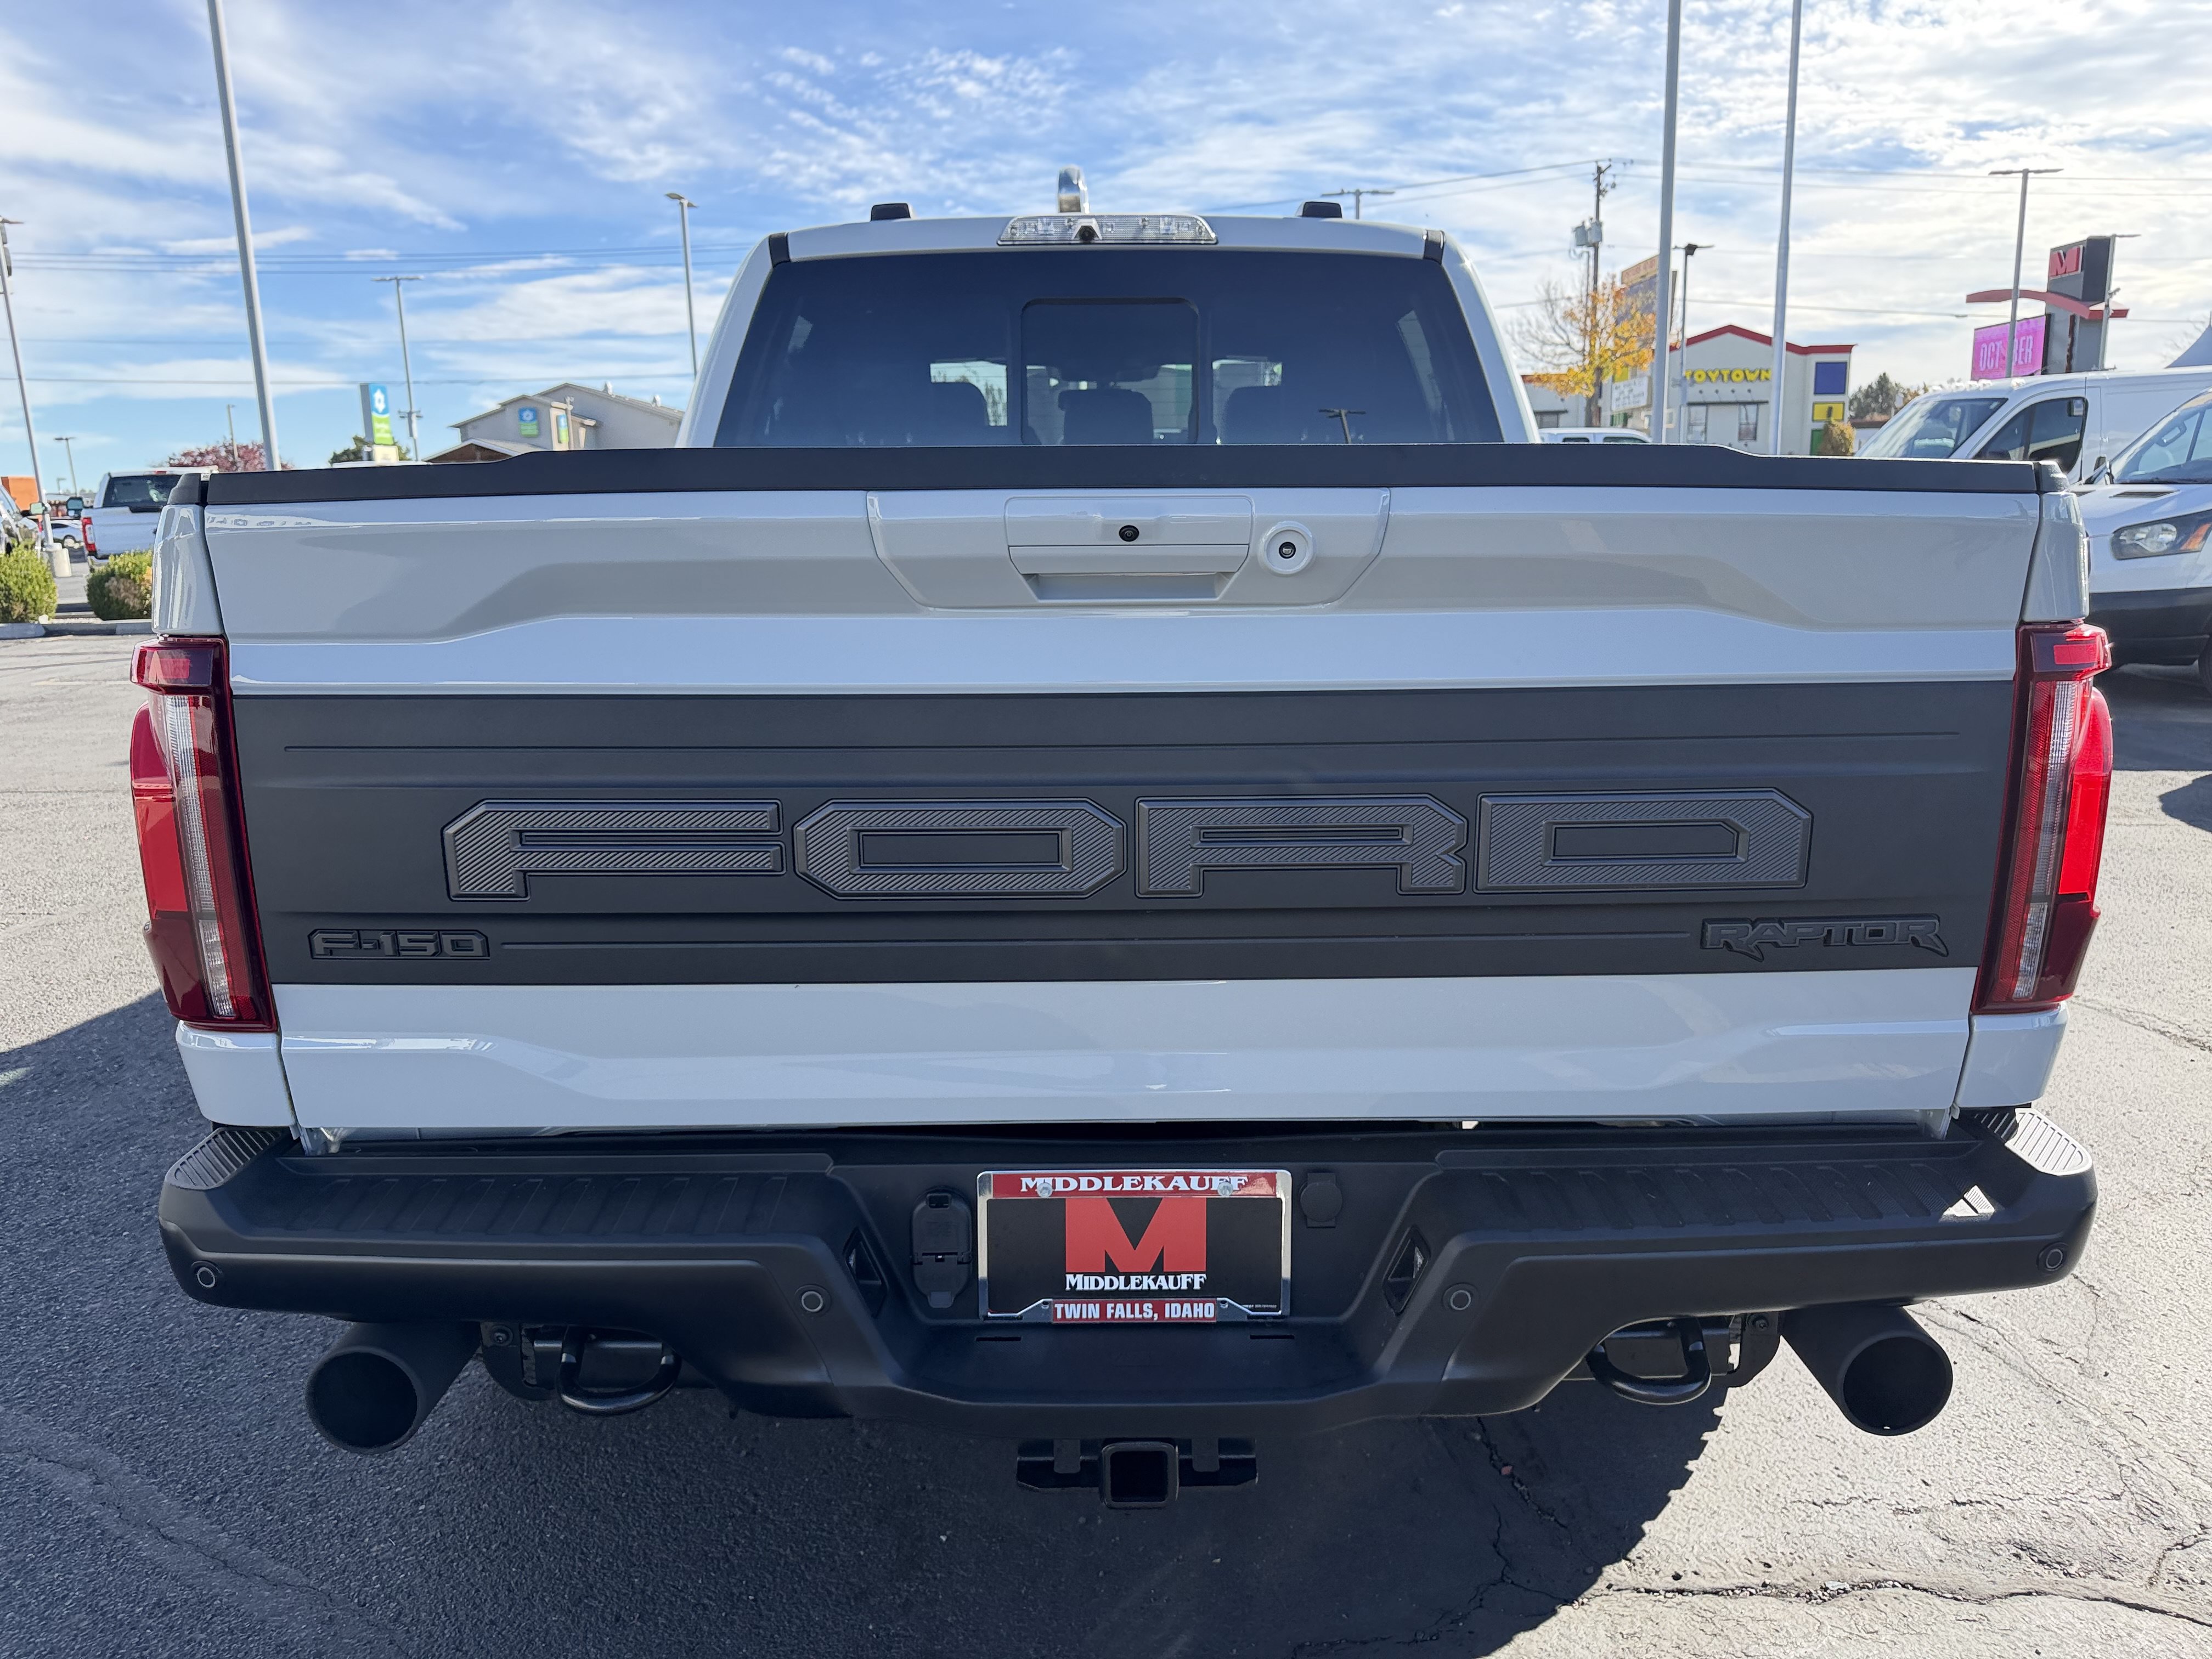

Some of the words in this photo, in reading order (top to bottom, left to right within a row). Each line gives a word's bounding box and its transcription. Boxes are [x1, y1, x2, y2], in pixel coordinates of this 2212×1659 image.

[2049, 245, 2083, 280] M
[1979, 335, 2033, 371] OCTBER
[1684, 369, 1772, 383] TOYTOWN
[442, 788, 1814, 901] FORD
[311, 930, 488, 957] F-150
[1703, 916, 1948, 961] RAPTOR
[1065, 1198, 1207, 1272] M
[1054, 1304, 1100, 1319] TWIN
[1106, 1304, 1158, 1321] FALLS,
[1165, 1303, 1216, 1318] IDAHO
